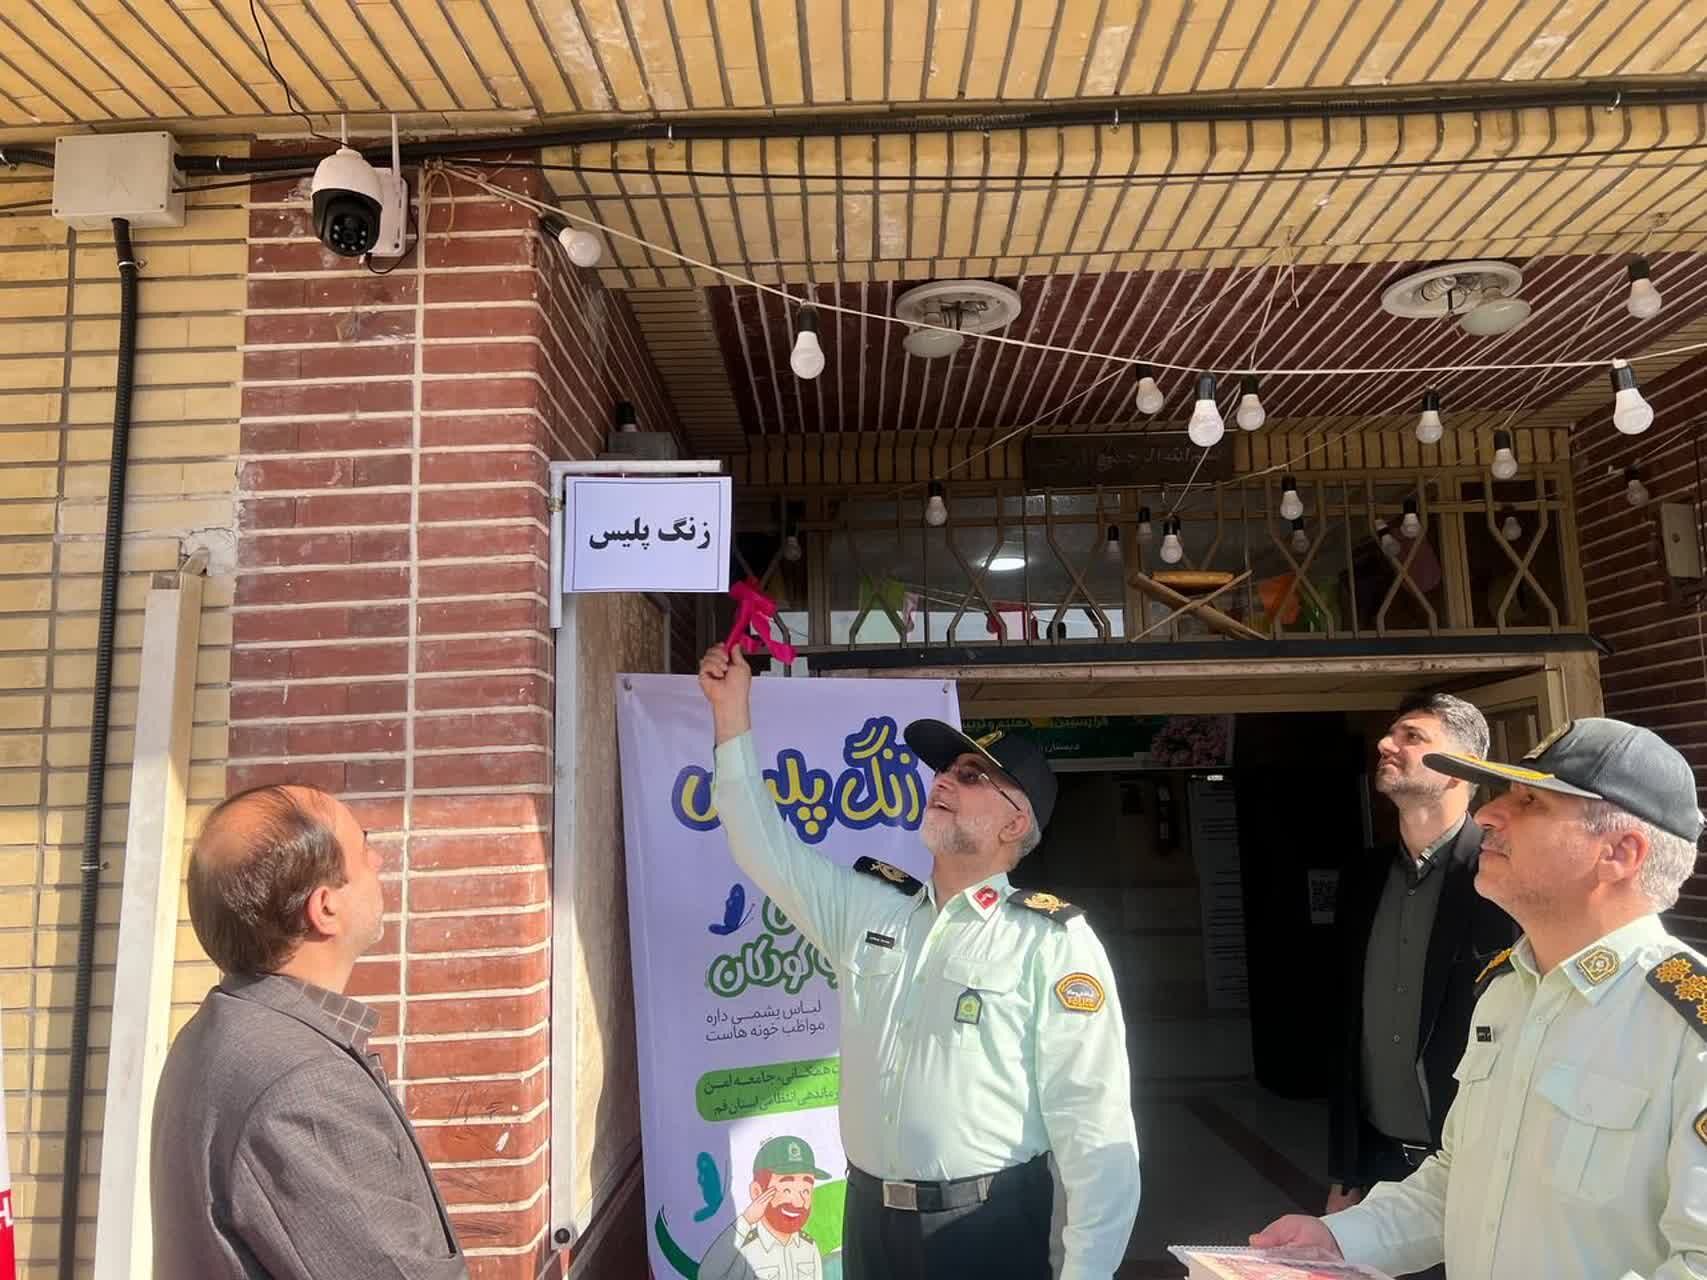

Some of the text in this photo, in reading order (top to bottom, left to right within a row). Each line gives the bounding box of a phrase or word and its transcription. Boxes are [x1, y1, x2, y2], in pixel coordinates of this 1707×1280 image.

[589, 516, 711, 550] زنگ پلیس
[672, 718, 925, 844] زنگ پل
[706, 1008, 729, 1026] داره
[782, 999, 822, 1020] لباس
[705, 1018, 825, 1042] مواظب خونه هاست
